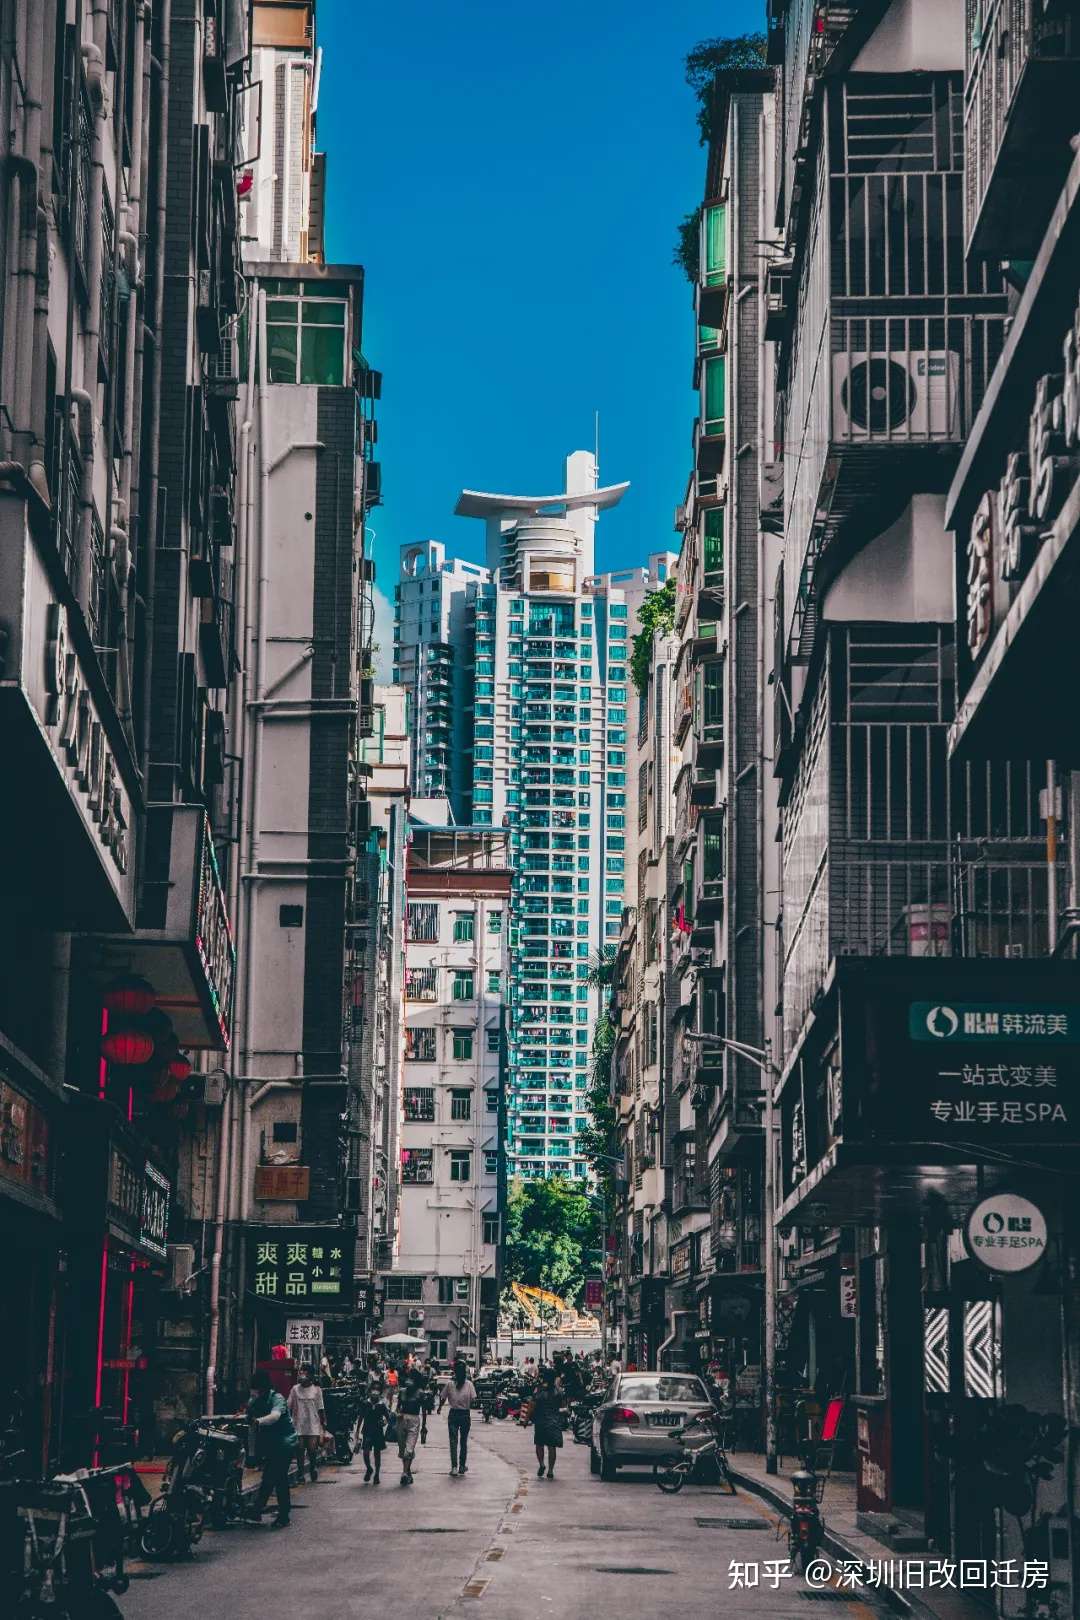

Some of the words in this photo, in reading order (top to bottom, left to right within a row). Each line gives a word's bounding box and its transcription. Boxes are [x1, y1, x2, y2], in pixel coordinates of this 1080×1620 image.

[1002, 1013, 1069, 1035] 韩流美
[938, 1063, 1057, 1087] 一站式变美
[929, 1099, 1067, 1124] 专业手足SPA
[256, 1241, 309, 1266] 爽爽
[311, 1247, 342, 1260] 糖水
[973, 1235, 1044, 1249] 专业手足SPA
[255, 1271, 307, 1296] 甜品
[289, 1324, 320, 1341] 生滚粥
